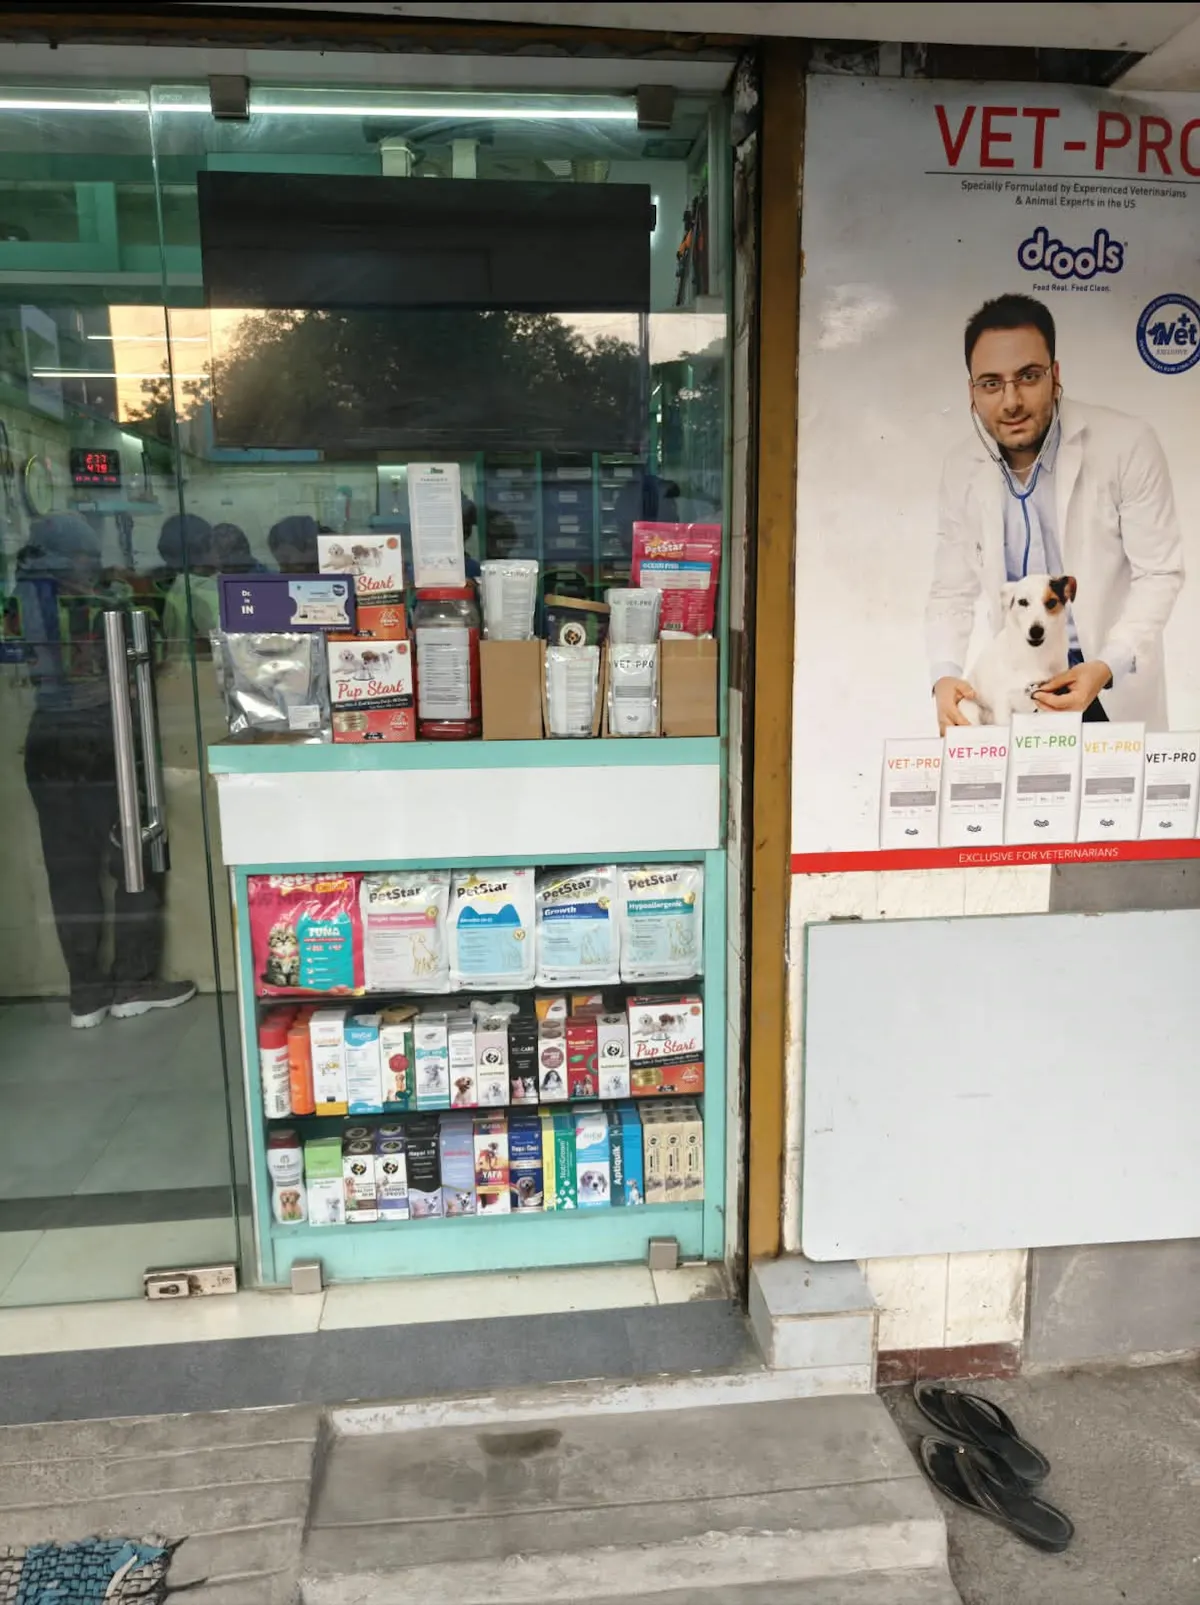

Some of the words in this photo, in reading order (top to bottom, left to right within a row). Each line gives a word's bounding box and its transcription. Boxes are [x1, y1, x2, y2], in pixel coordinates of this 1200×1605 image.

[961, 180, 1003, 193] Specially
[1004, 181, 1057, 193] Formulated
[1060, 183, 1071, 195] by
[1073, 183, 1128, 196] Experienced
[1130, 186, 1187, 198] Veterinarians
[1015, 195, 1023, 205] &
[1025, 196, 1057, 206] Animal
[1060, 197, 1096, 208] Experts
[1097, 199, 1105, 207] in
[1107, 199, 1121, 208] the
[1123, 200, 1136, 208] US
[1018, 226, 1124, 280] drools
[357, 575, 394, 592] Start
[338, 683, 362, 702] Pup
[367, 680, 405, 697] Start
[1016, 735, 1077, 749] VET-PRO
[1084, 740, 1142, 753] VET-PRO
[948, 746, 1007, 759] VET-PRO
[1146, 752, 1197, 763] VET-PRO
[887, 758, 941, 770] VET-PRO
[959, 851, 1014, 863] EXCLUSIVE
[1016, 850, 1038, 861] FOR
[1039, 847, 1119, 861] VETERINARIANS
[628, 873, 678, 891] PetStar
[369, 888, 421, 903] PetStar
[542, 880, 592, 901] PetStar
[544, 906, 577, 916] Growth
[307, 926, 341, 937] TUNA
[637, 1043, 659, 1058] Pup
[663, 1039, 696, 1054] Start
